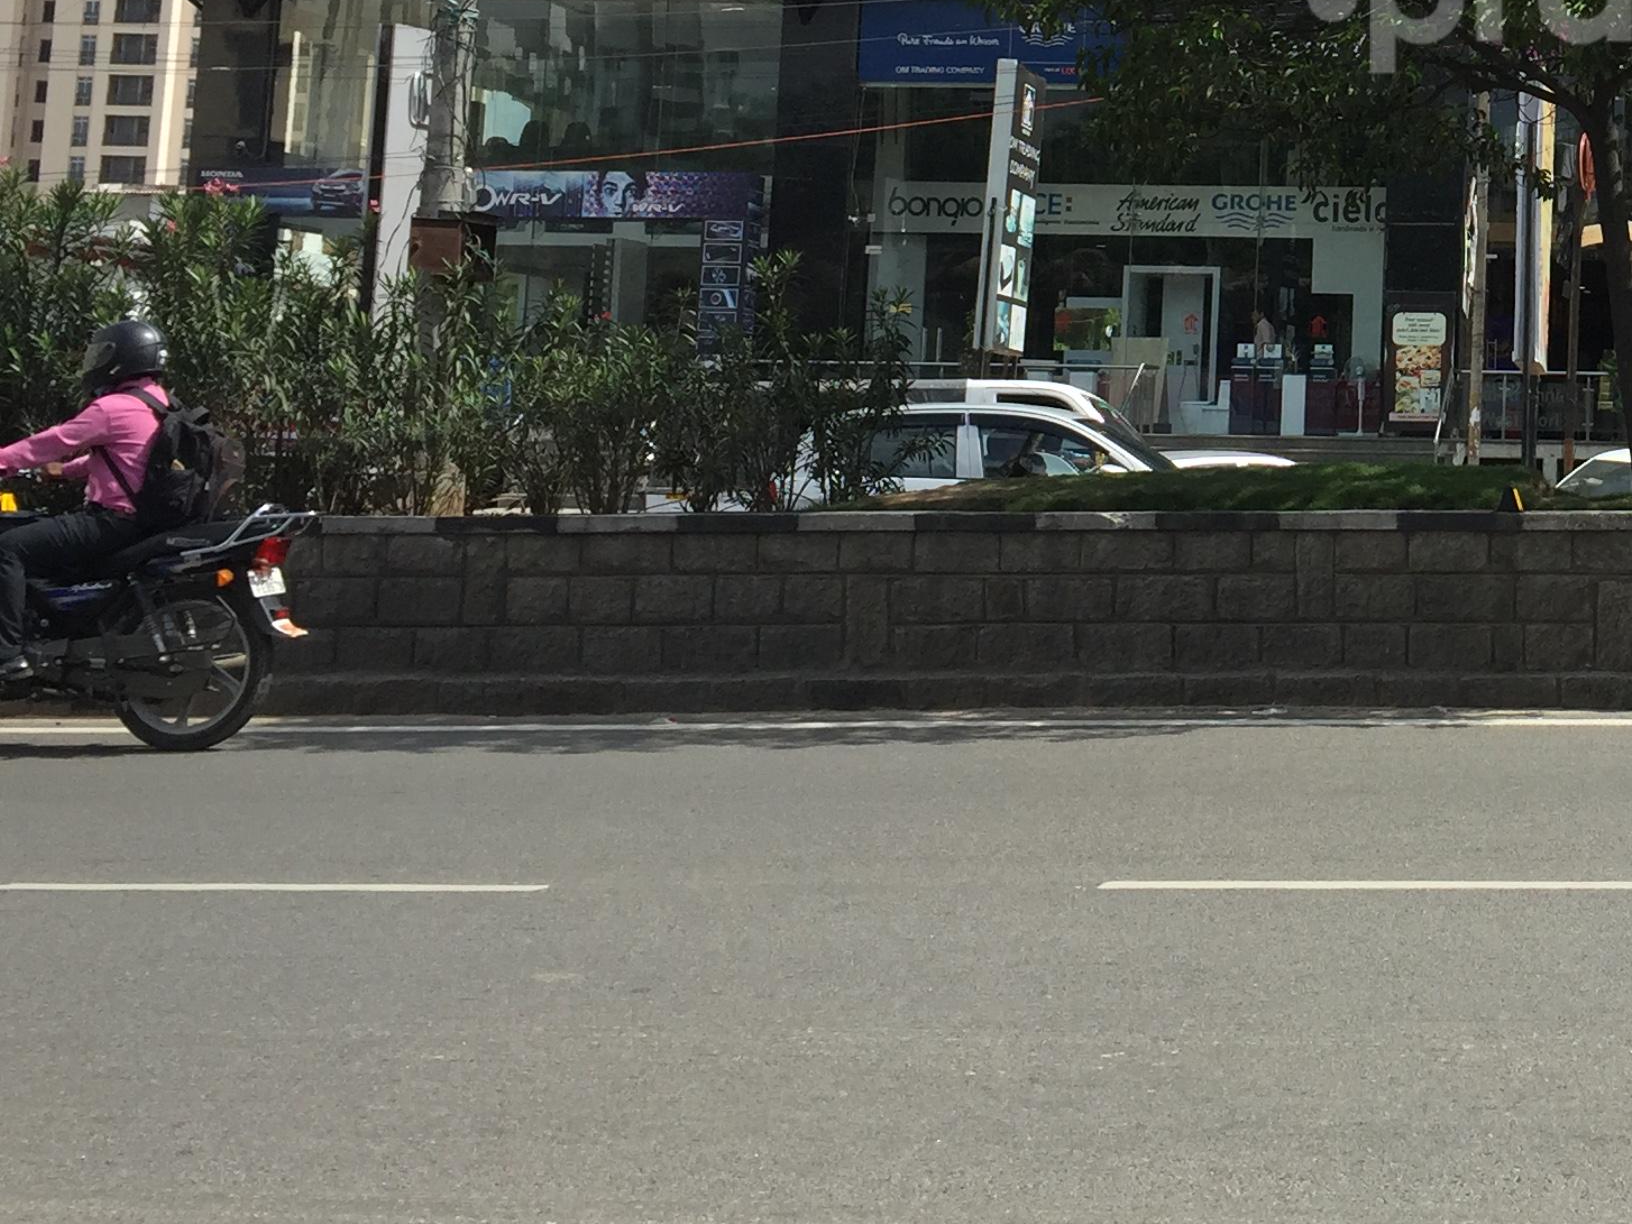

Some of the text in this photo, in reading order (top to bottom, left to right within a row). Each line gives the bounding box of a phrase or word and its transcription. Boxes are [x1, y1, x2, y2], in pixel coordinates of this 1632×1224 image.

[200, 170, 243, 178] HONDA
[495, 191, 563, 206] WR-V
[1116, 190, 1200, 212] American
[1211, 193, 1297, 212] GROHE
